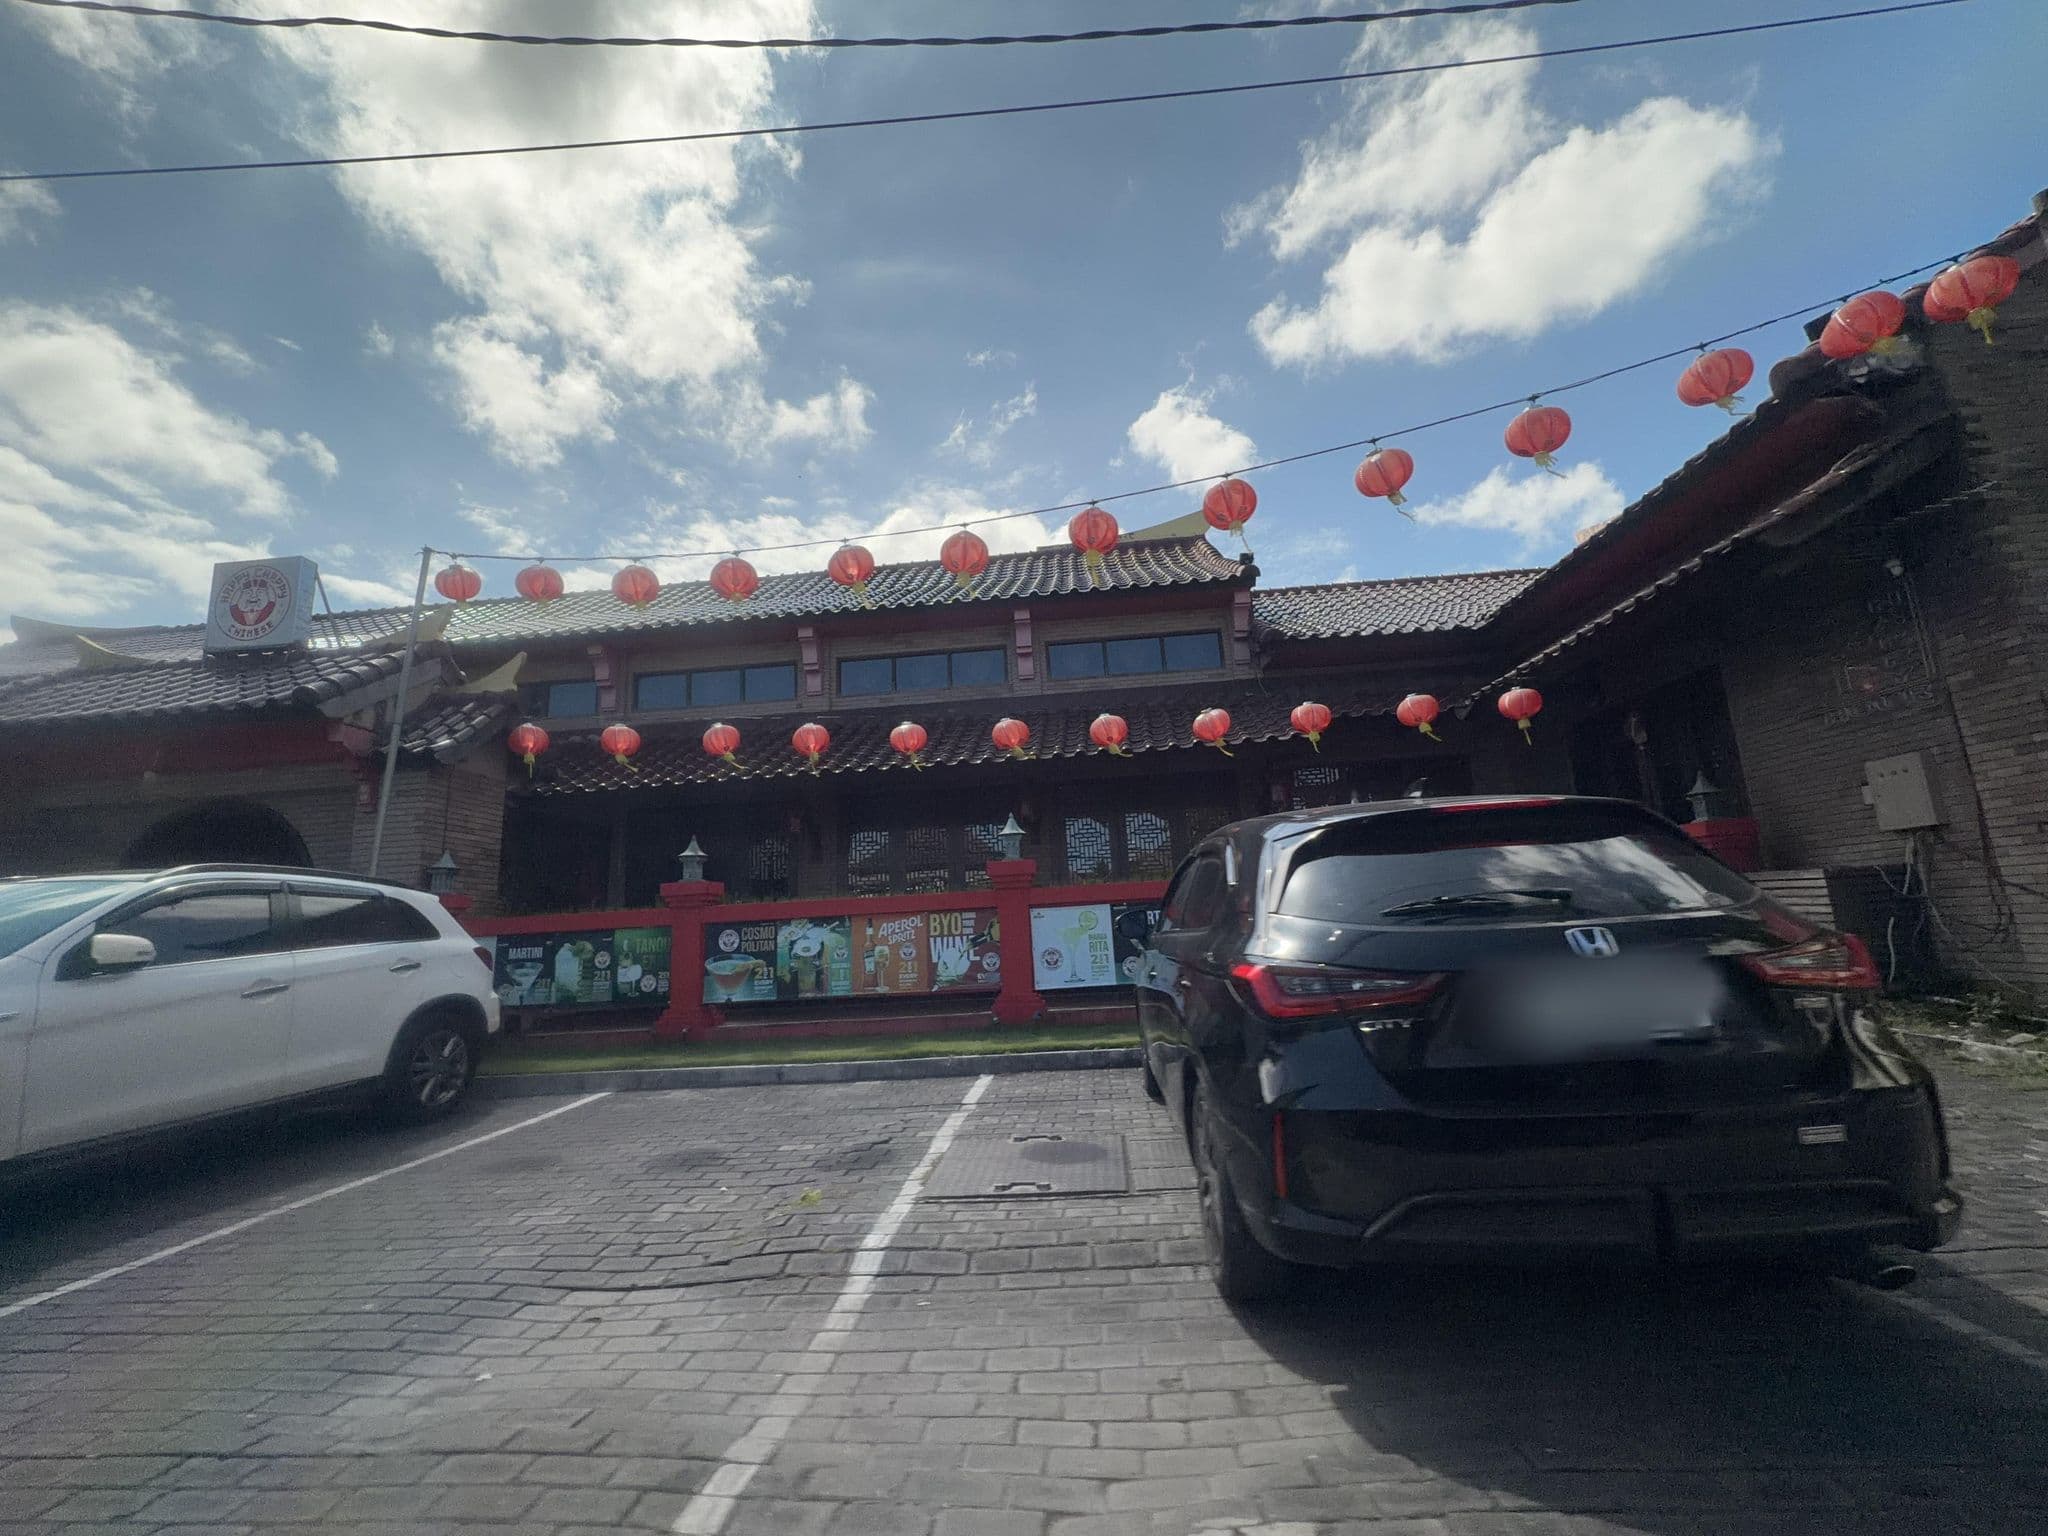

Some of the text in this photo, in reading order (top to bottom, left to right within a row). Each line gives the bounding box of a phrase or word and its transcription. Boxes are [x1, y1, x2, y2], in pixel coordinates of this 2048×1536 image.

[220, 568, 289, 603] HAPPY CHAPPY
[229, 621, 274, 637] CHINESE
[878, 915, 923, 939] APEROL
[929, 911, 962, 936] BYO
[741, 926, 775, 941] COSMO
[887, 930, 916, 945] SPRITZ
[508, 946, 544, 960] MARTINI
[741, 940, 775, 953] POLITAN
[1089, 940, 1109, 953] RITA
